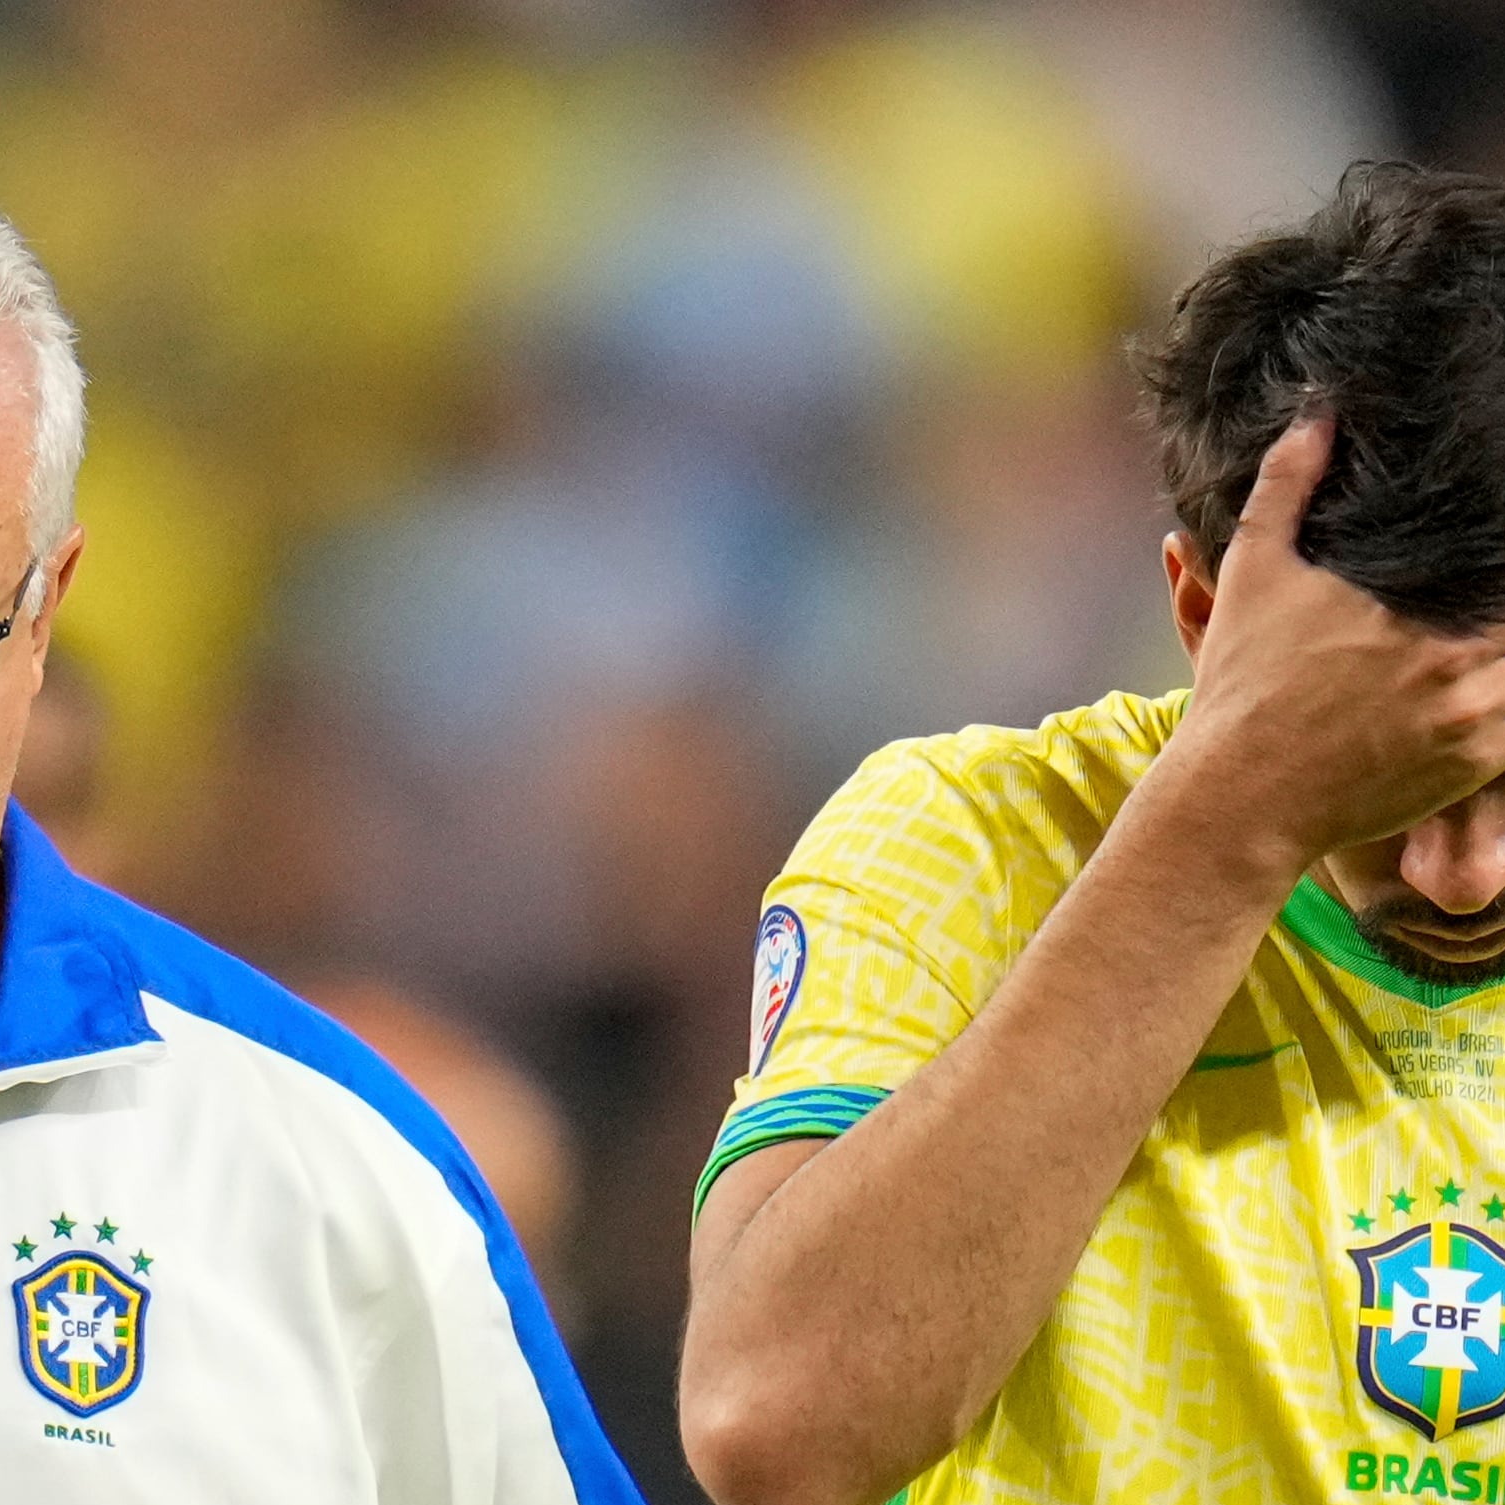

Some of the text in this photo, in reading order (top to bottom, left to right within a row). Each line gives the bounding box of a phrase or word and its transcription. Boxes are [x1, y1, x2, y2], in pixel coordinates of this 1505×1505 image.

[1374, 1029, 1433, 1050] URUGUAI
[1458, 1032, 1504, 1054] BRASIL
[1390, 1054, 1414, 1076] LAS
[1475, 1058, 1495, 1078] NV
[1408, 1078, 1454, 1099] JULHO
[61, 1318, 102, 1339] CBF
[1411, 1302, 1481, 1331] CBF
[43, 1423, 116, 1448] BRASIL
